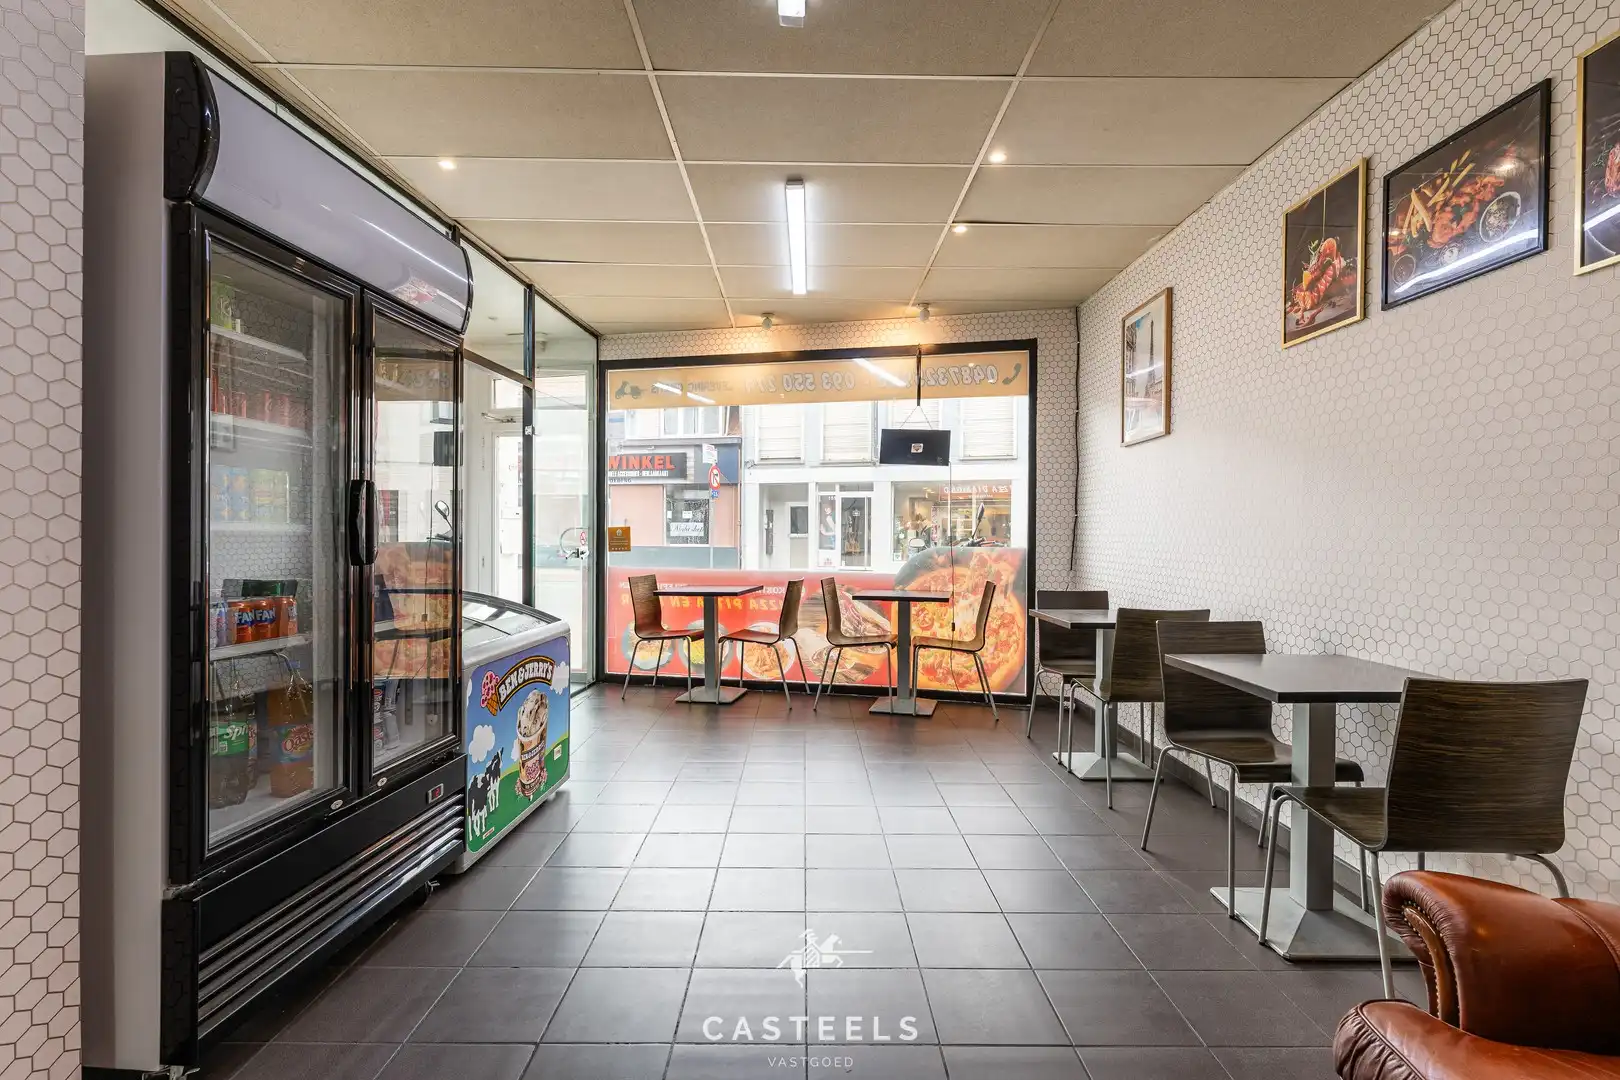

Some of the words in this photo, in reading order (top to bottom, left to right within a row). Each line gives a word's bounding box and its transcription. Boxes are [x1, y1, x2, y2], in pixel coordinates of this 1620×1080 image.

[609, 456, 676, 471] WINKEL
[499, 671, 518, 702] BEN
[525, 661, 552, 680] JERRY'S
